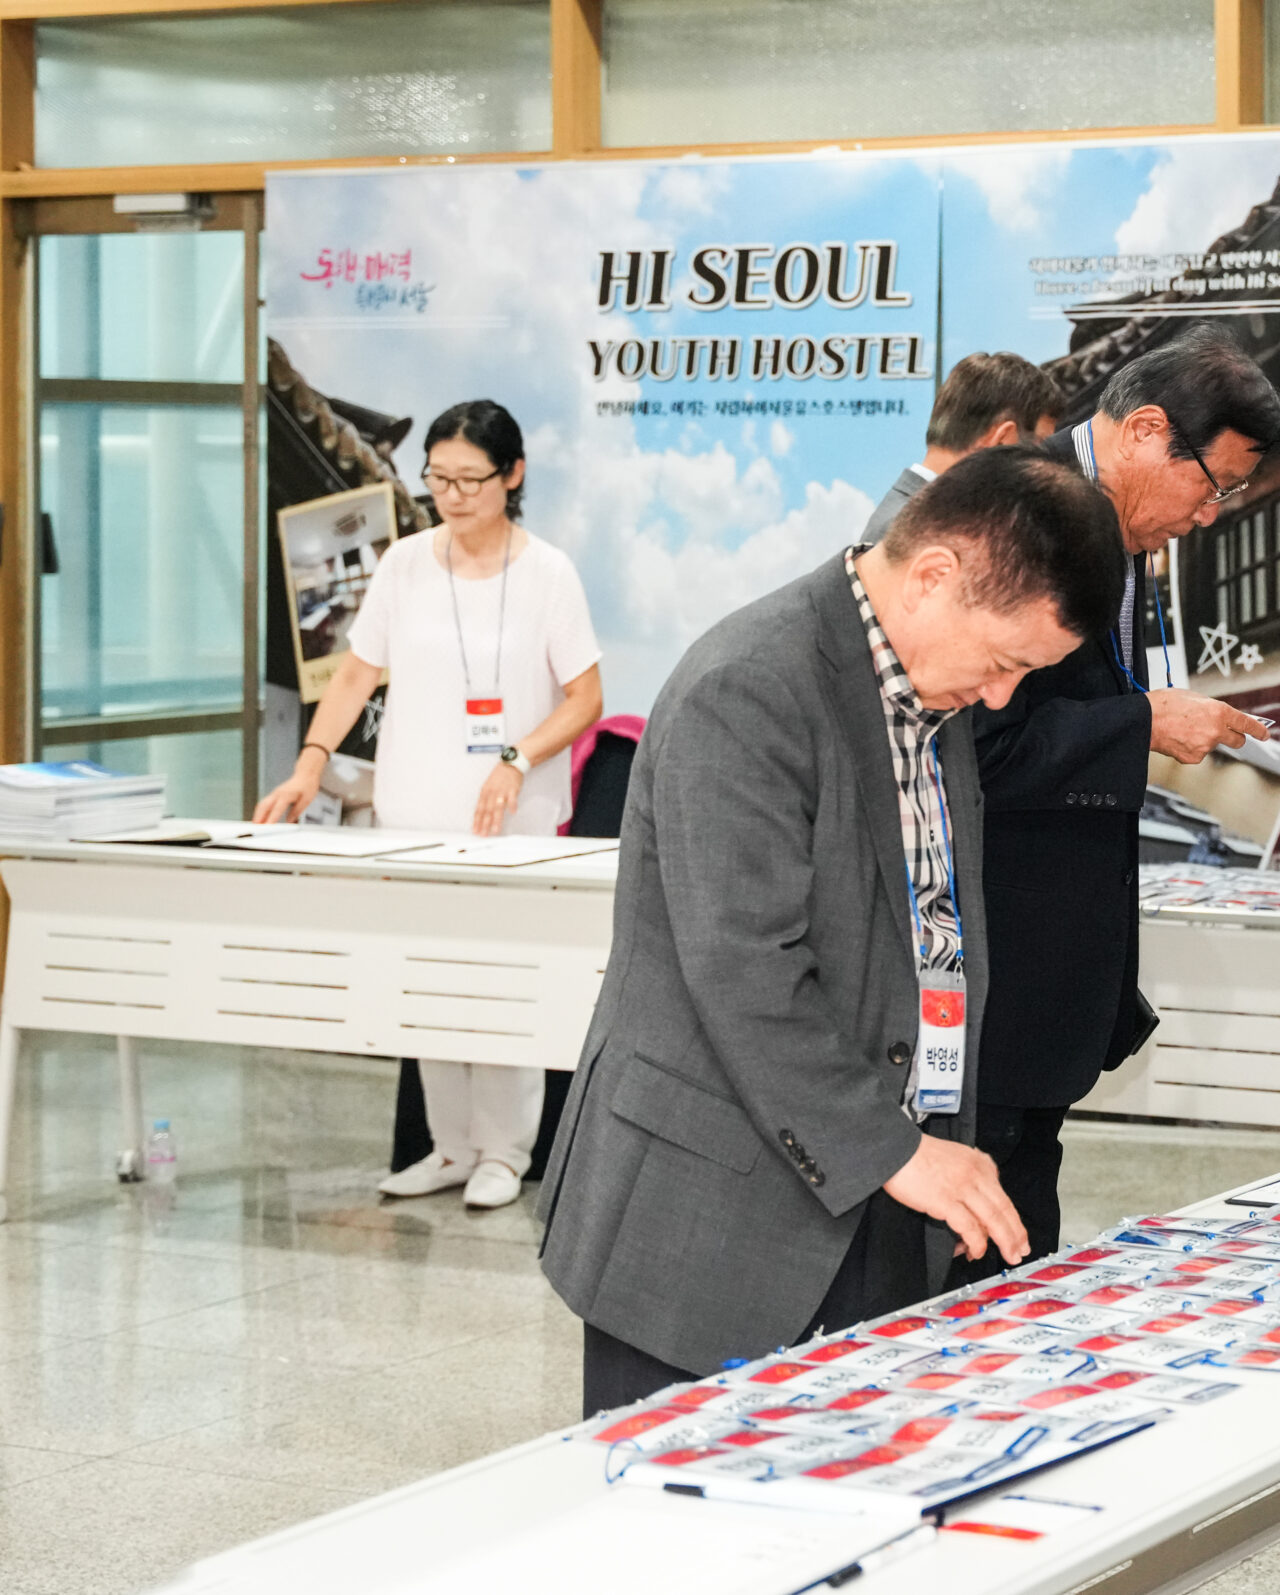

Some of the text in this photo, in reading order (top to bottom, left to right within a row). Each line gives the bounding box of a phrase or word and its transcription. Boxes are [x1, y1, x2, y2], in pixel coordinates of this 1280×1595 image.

[598, 241, 912, 311] HI SEOUL
[1172, 276, 1207, 295] day
[1208, 273, 1245, 290] with
[586, 335, 930, 381] YOUTH HOSTEL
